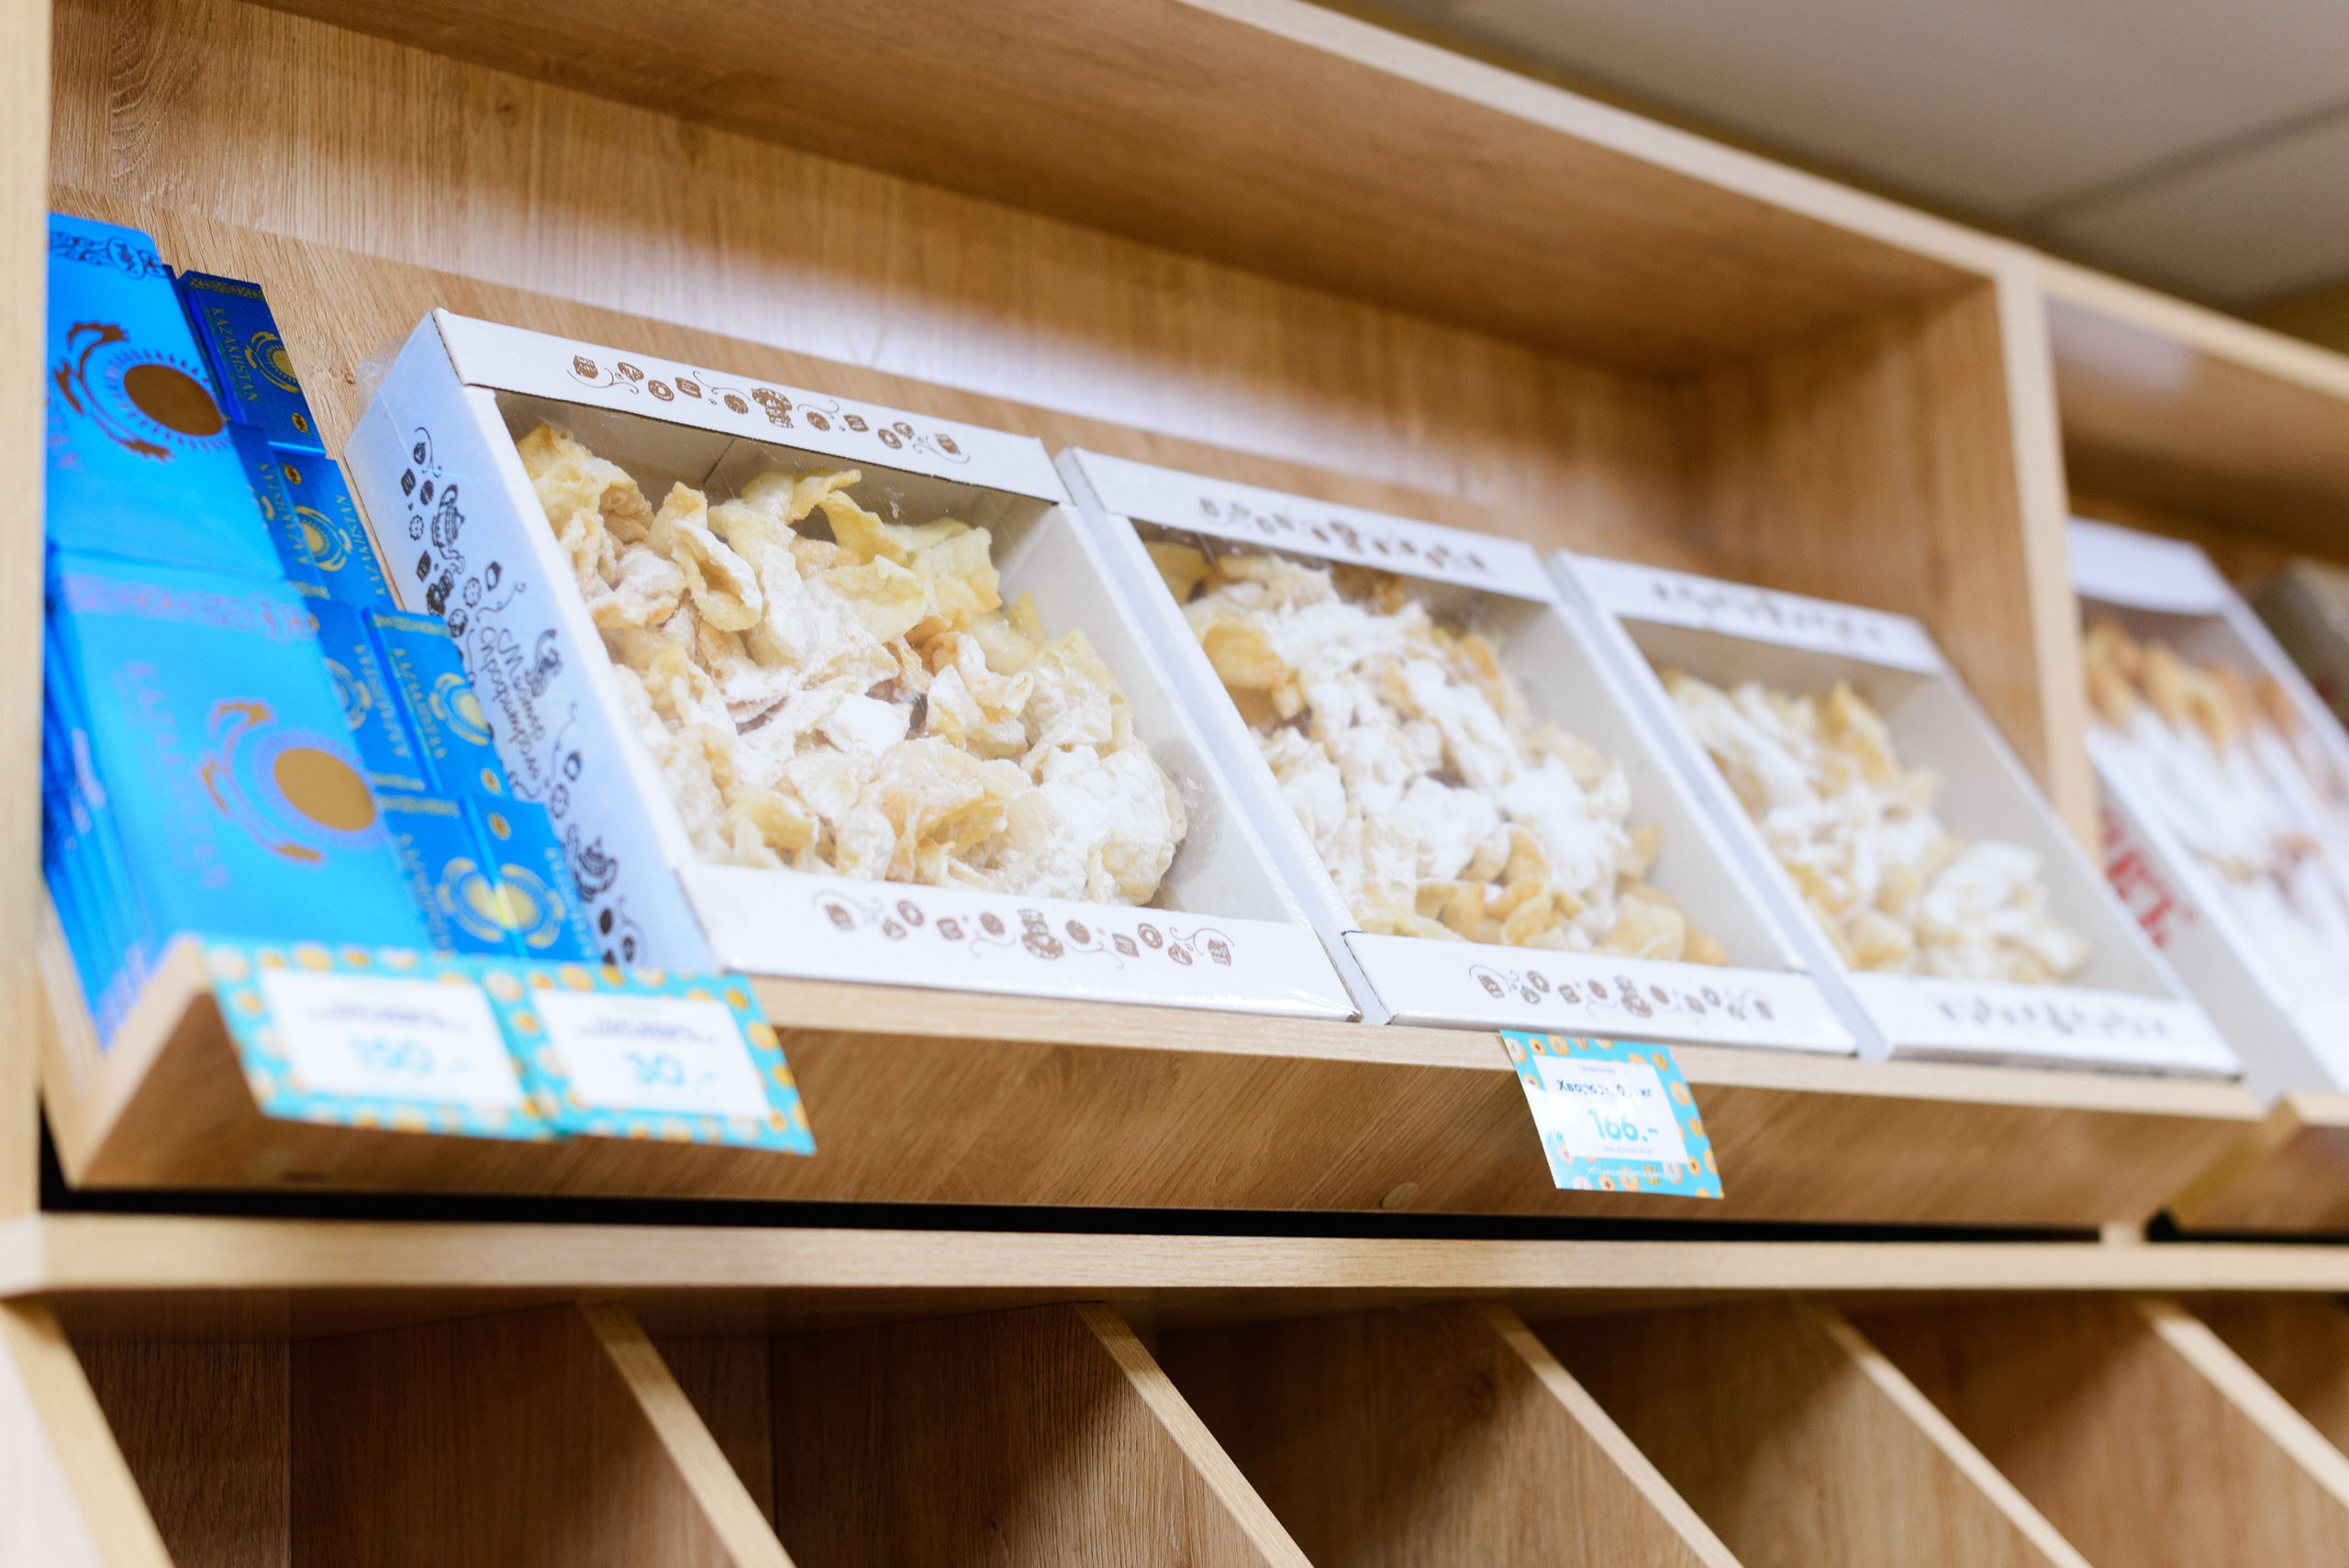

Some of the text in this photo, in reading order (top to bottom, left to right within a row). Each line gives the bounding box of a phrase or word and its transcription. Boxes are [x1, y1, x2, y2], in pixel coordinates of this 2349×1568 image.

[211, 306, 261, 402] KAZAKHSTAN
[335, 494, 387, 595] KAZAKHSTAN
[497, 628, 547, 740] Мистер
